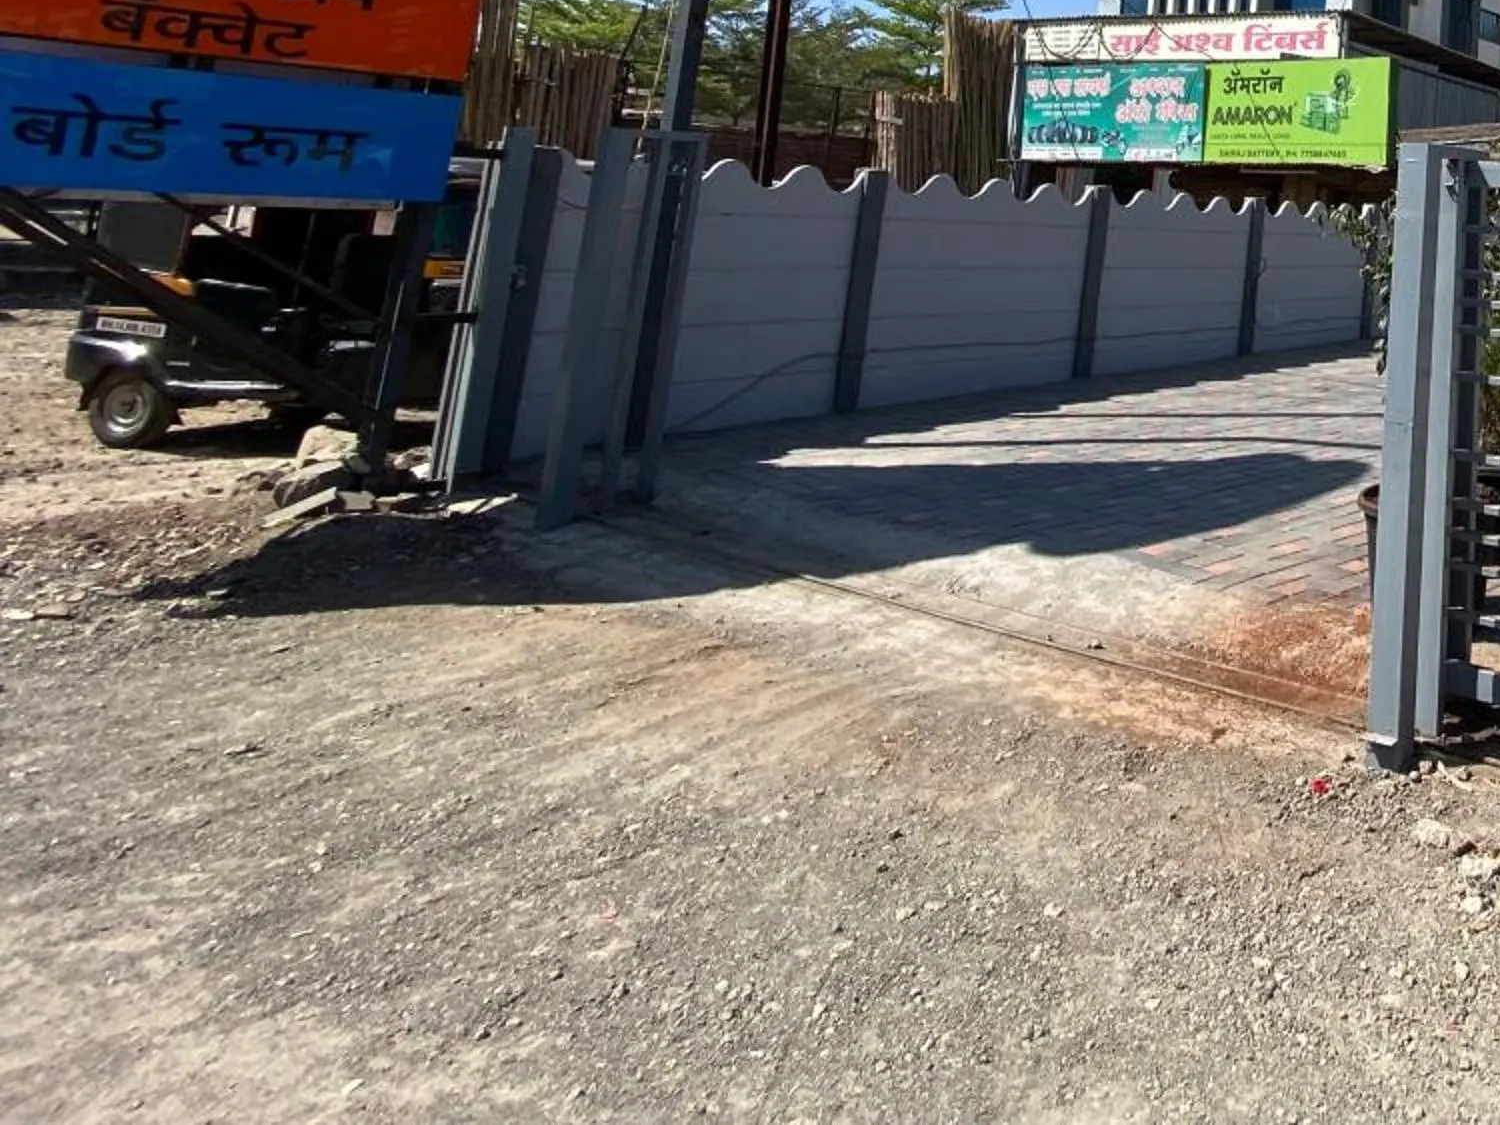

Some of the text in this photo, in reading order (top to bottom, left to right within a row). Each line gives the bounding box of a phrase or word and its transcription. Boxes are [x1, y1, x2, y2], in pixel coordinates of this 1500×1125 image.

[1110, 26, 1162, 56] साई
[1170, 32, 1233, 53] अश्व
[1244, 23, 1329, 52] टिंबर्स
[1211, 104, 1294, 126] AMARON
[10, 92, 370, 172] बोर्ड रूम
